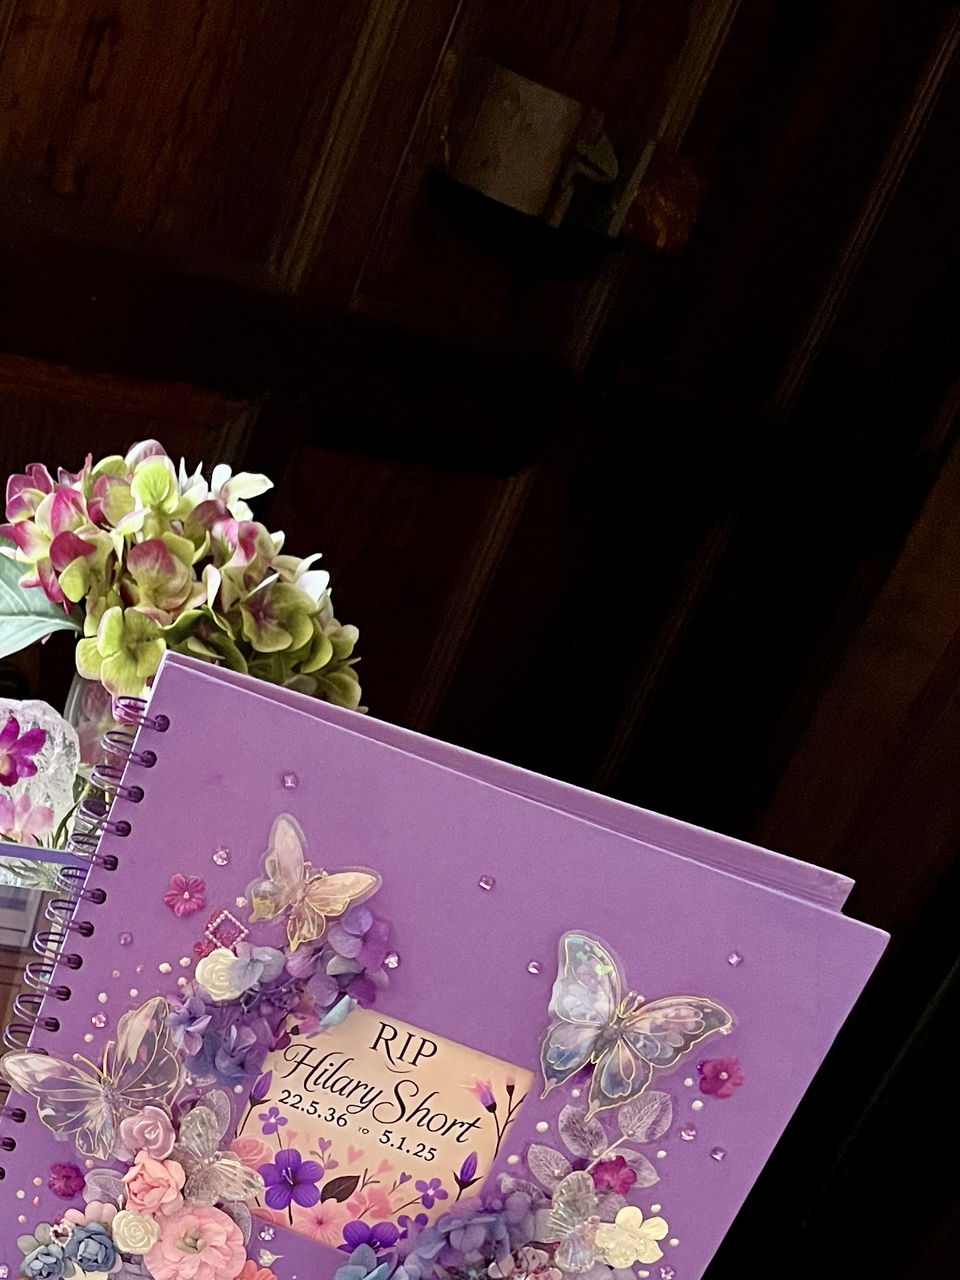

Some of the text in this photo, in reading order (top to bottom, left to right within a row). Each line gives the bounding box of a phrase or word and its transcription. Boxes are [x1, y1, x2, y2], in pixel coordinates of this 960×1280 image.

[368, 1021, 438, 1067] RIP
[278, 1089, 348, 1128] 22.5.36
[378, 1129, 438, 1162] 5.1.25
[280, 1043, 483, 1144] Hilary Short
